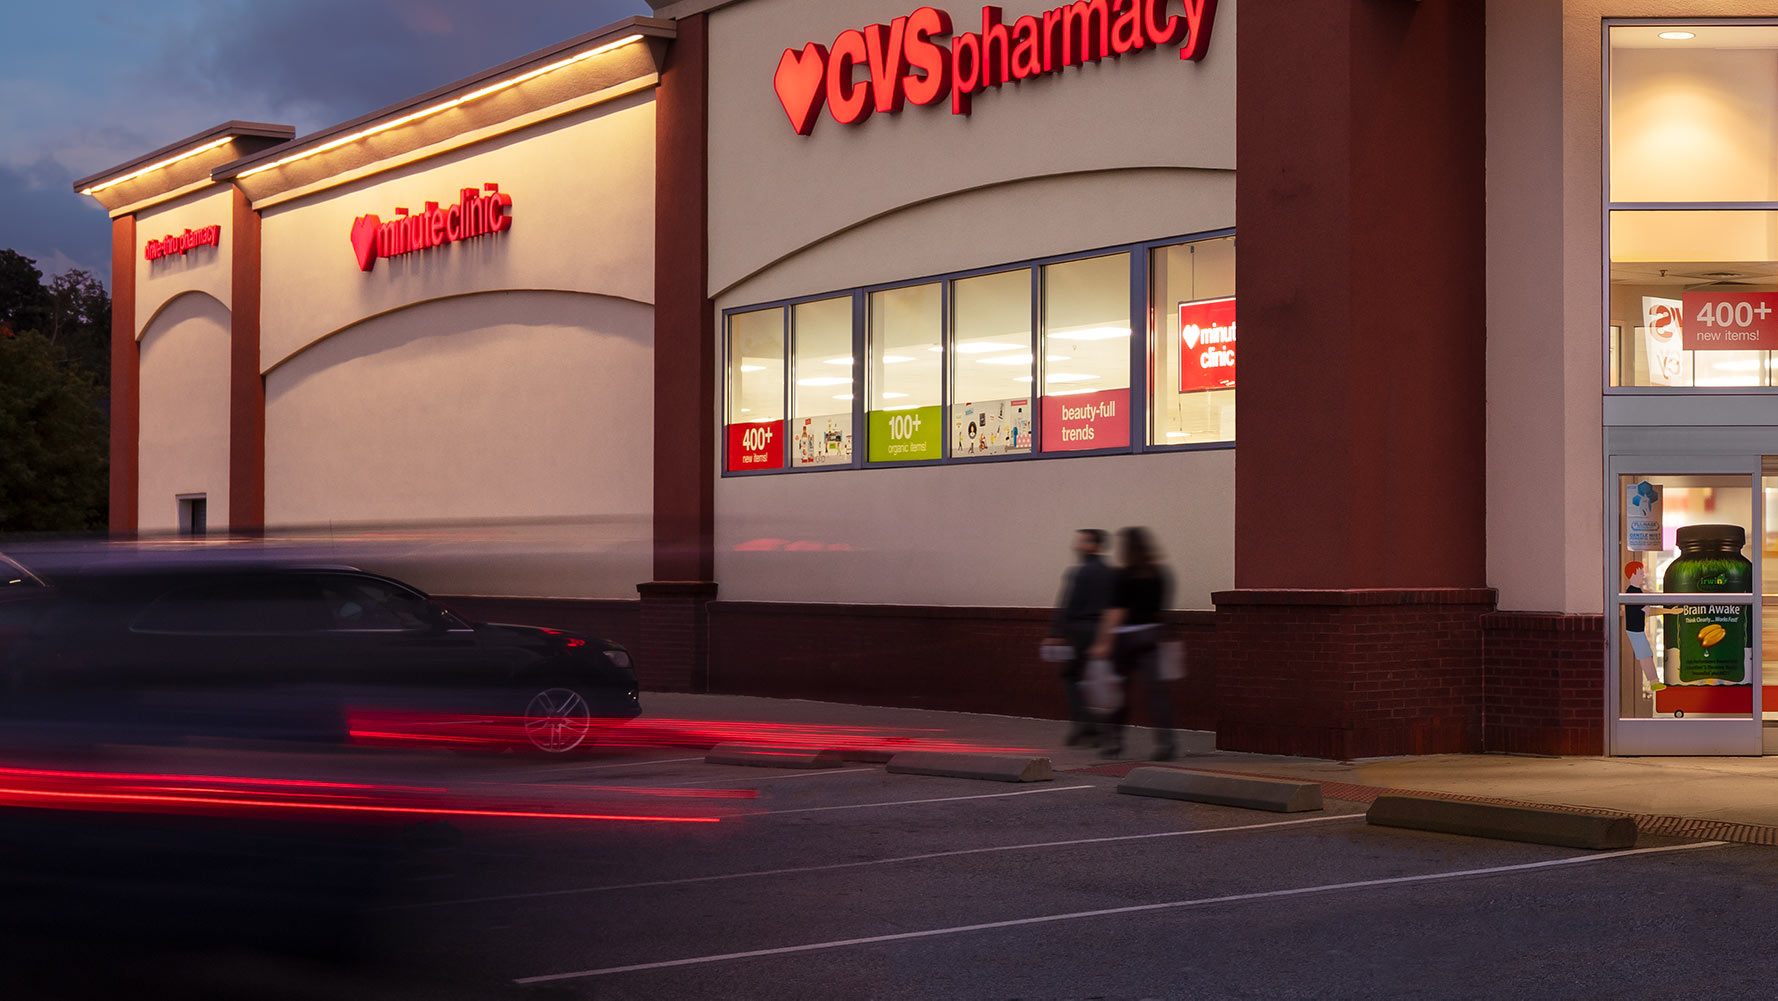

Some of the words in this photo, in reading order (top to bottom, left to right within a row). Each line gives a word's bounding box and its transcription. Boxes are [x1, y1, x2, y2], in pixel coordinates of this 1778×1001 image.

[826, 6, 954, 124] CVS
[1696, 301, 1772, 327] 400+
[1200, 322, 1236, 345] minut
[1696, 331, 1721, 341] new
[1724, 330, 1760, 341] items!
[1200, 347, 1235, 369] clinic
[1061, 401, 1116, 422] beauty-full
[888, 414, 922, 440] 100+
[1061, 424, 1095, 442] trends
[742, 426, 773, 452] 400+
[888, 442, 909, 456] organic
[909, 441, 927, 454] items!
[742, 453, 754, 464] new
[753, 452, 769, 463] items!
[1683, 605, 1707, 616] Brain
[1708, 605, 1740, 615] Awake
